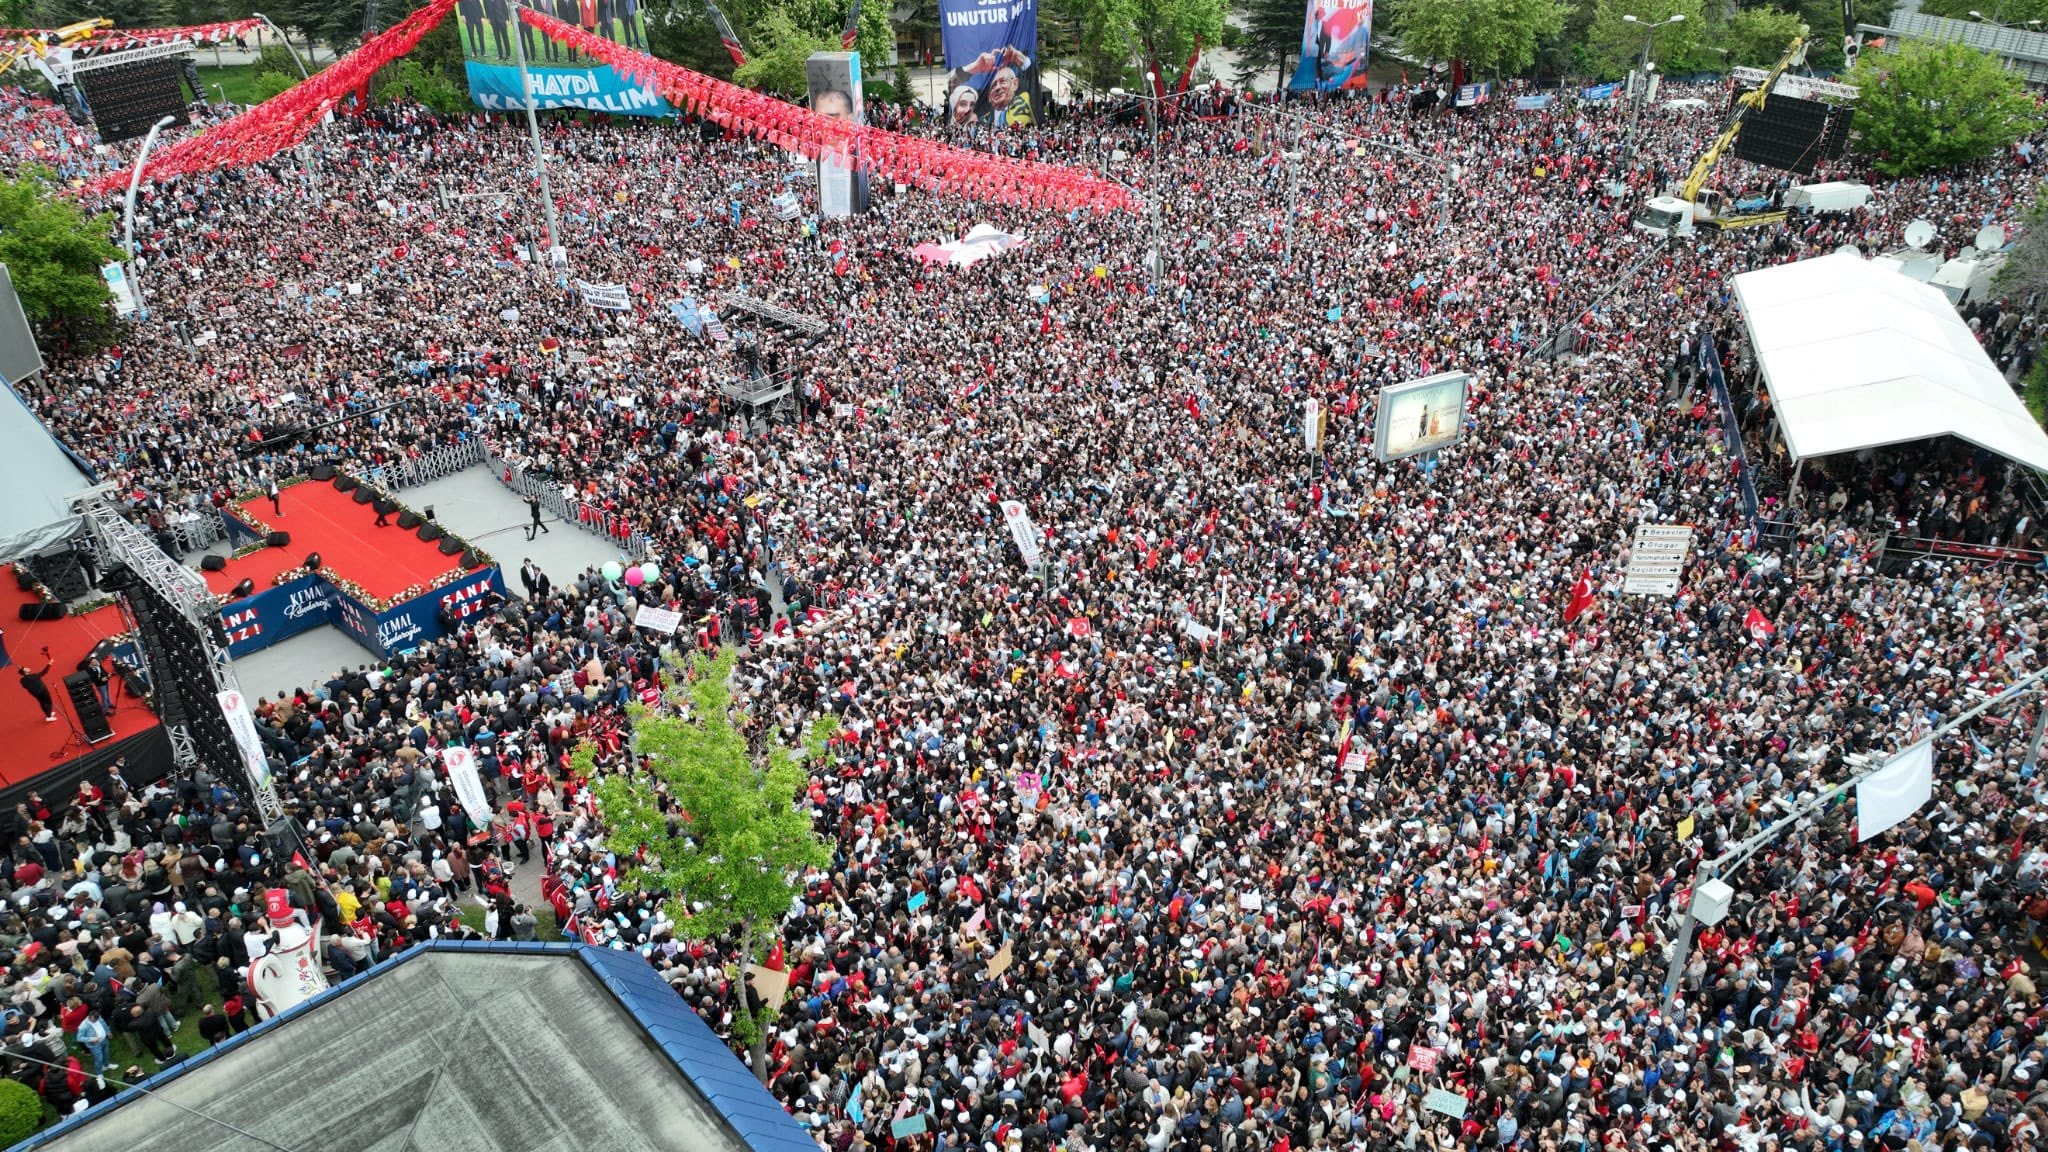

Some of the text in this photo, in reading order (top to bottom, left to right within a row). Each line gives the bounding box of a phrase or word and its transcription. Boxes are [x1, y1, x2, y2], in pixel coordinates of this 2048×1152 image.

[946, 8, 1008, 27] UNUTUR
[526, 70, 600, 96] HAYDİ
[1647, 541, 1679, 549] Otogar
[377, 612, 412, 638] KEMAL
